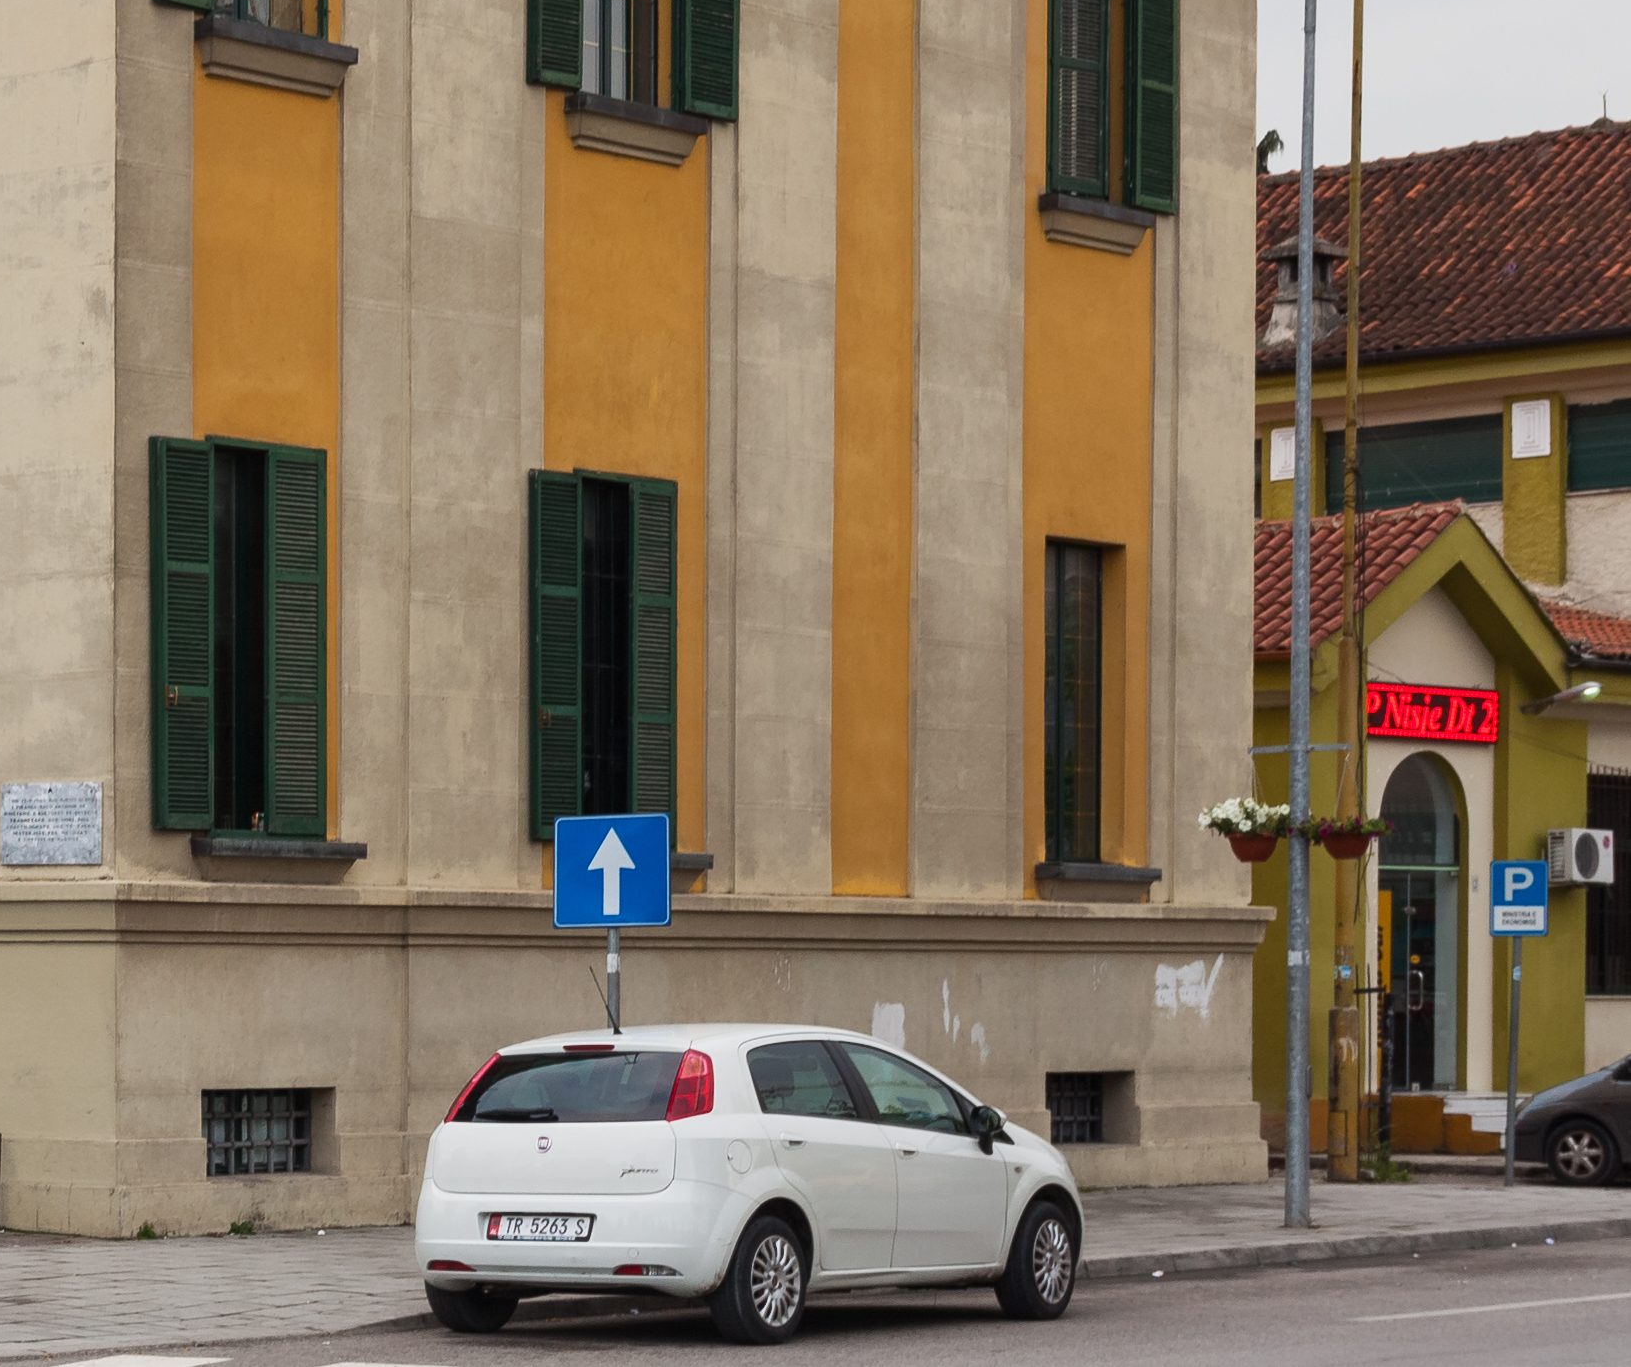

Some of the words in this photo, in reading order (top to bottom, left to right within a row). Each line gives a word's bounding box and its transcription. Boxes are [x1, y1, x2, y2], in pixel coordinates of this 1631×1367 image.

[1381, 692, 1443, 734] Nisje
[1504, 867, 1534, 902] P
[506, 1217, 523, 1234] TR
[530, 1217, 569, 1235] 5263
[574, 1218, 585, 1235] S
